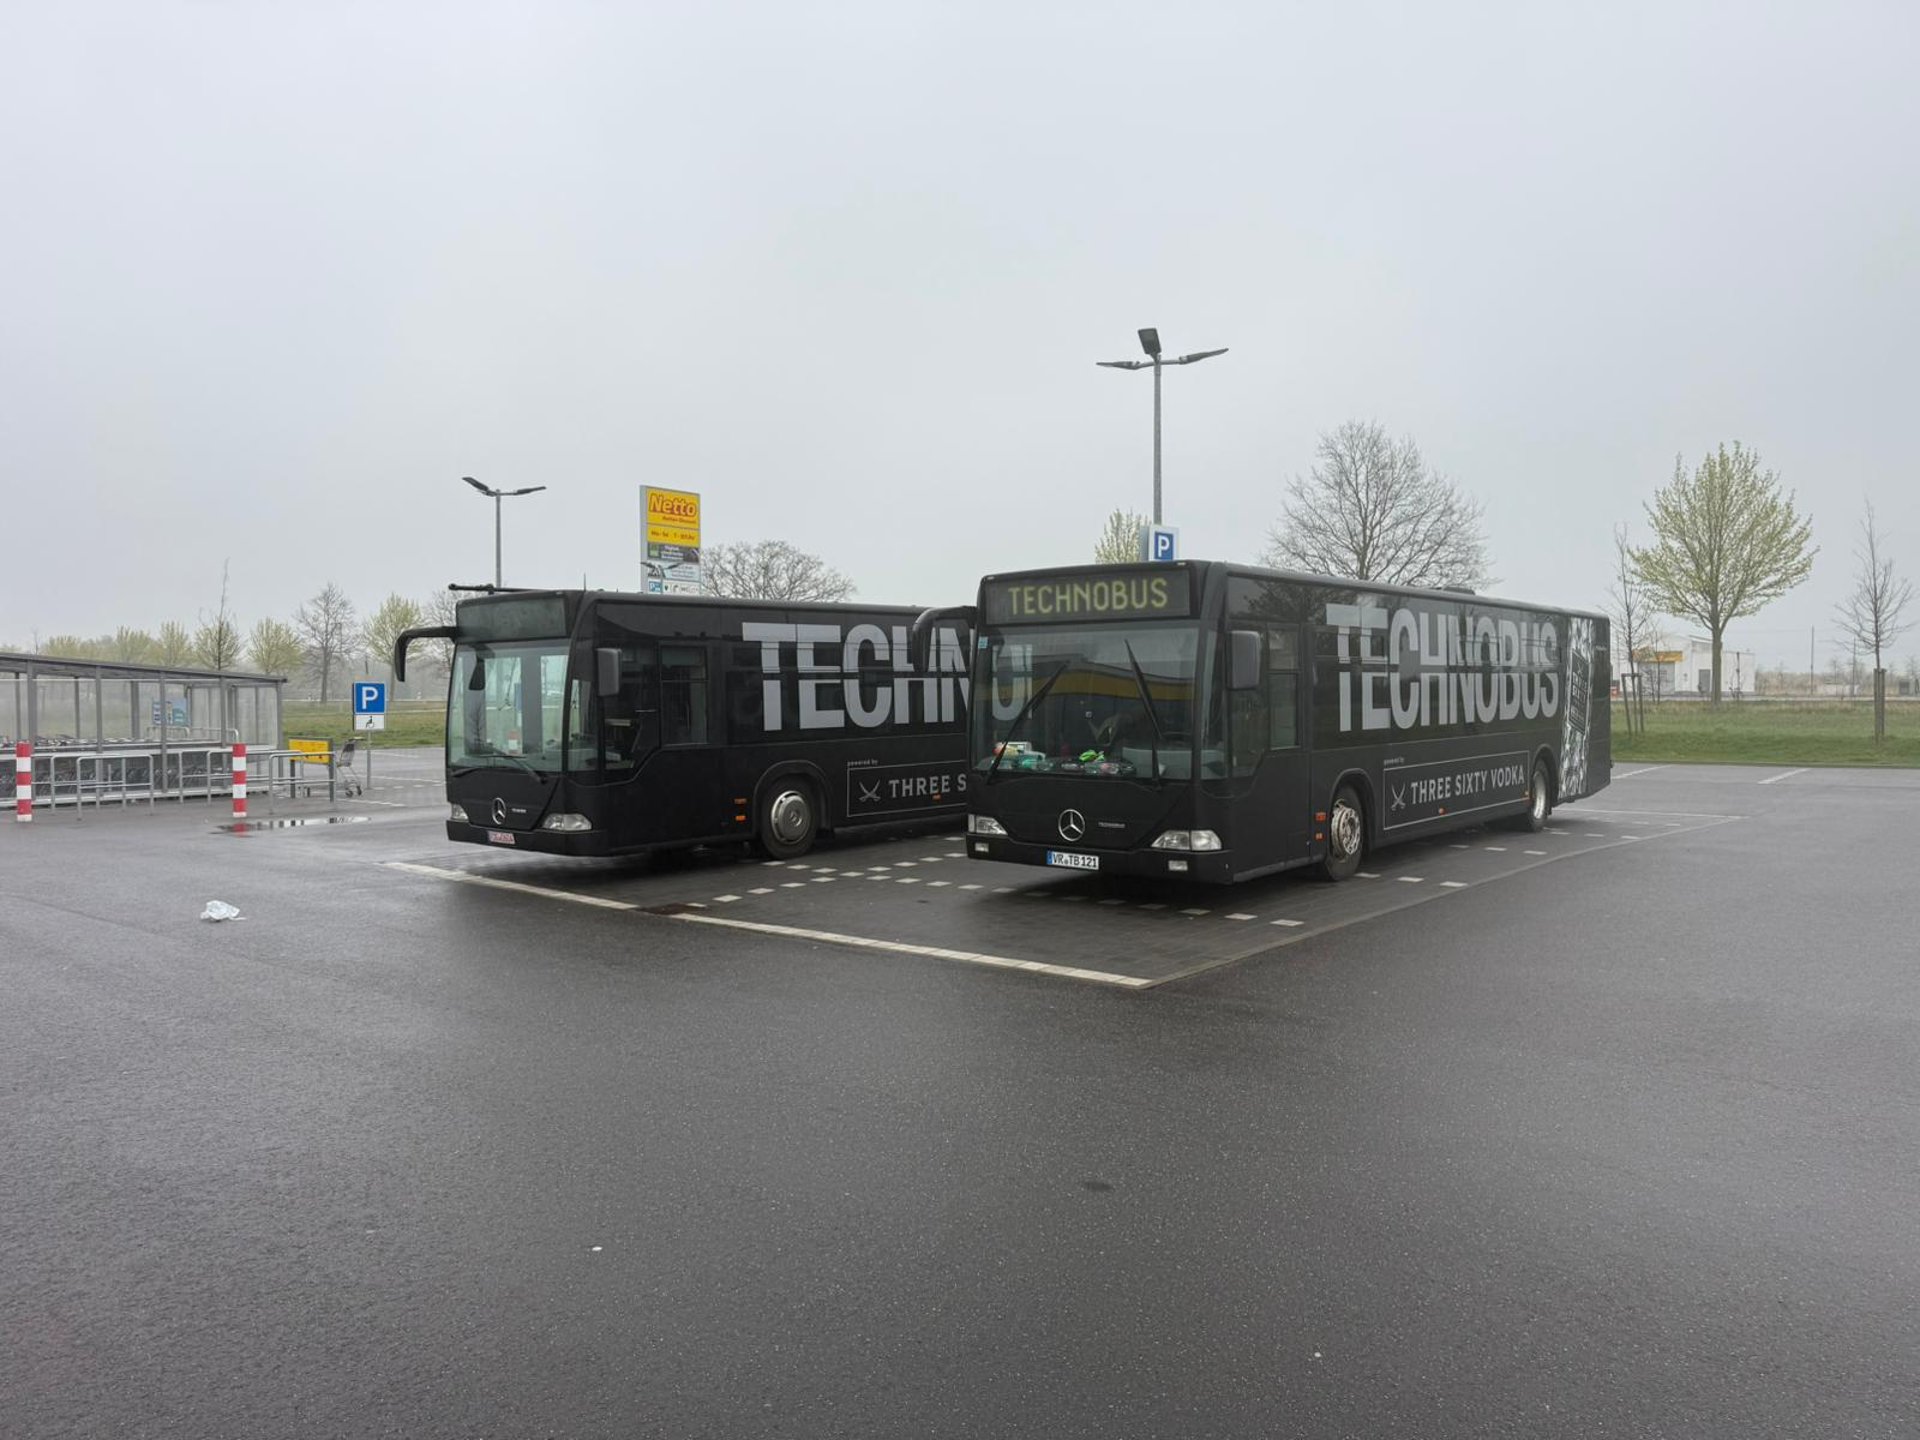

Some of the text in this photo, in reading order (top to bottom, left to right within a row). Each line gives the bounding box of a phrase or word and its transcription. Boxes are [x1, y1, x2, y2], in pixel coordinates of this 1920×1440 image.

[650, 493, 697, 517] Netto
[1157, 535, 1170, 558] P
[1008, 577, 1168, 615] TECHNOBUS
[1326, 603, 1559, 732] TECHNOBUS
[362, 686, 378, 710] P
[888, 773, 967, 798] THREE S
[1411, 765, 1525, 804] THREE SIXTY VODKA
[1053, 853, 1064, 865] VR
[1081, 856, 1097, 868] 121
